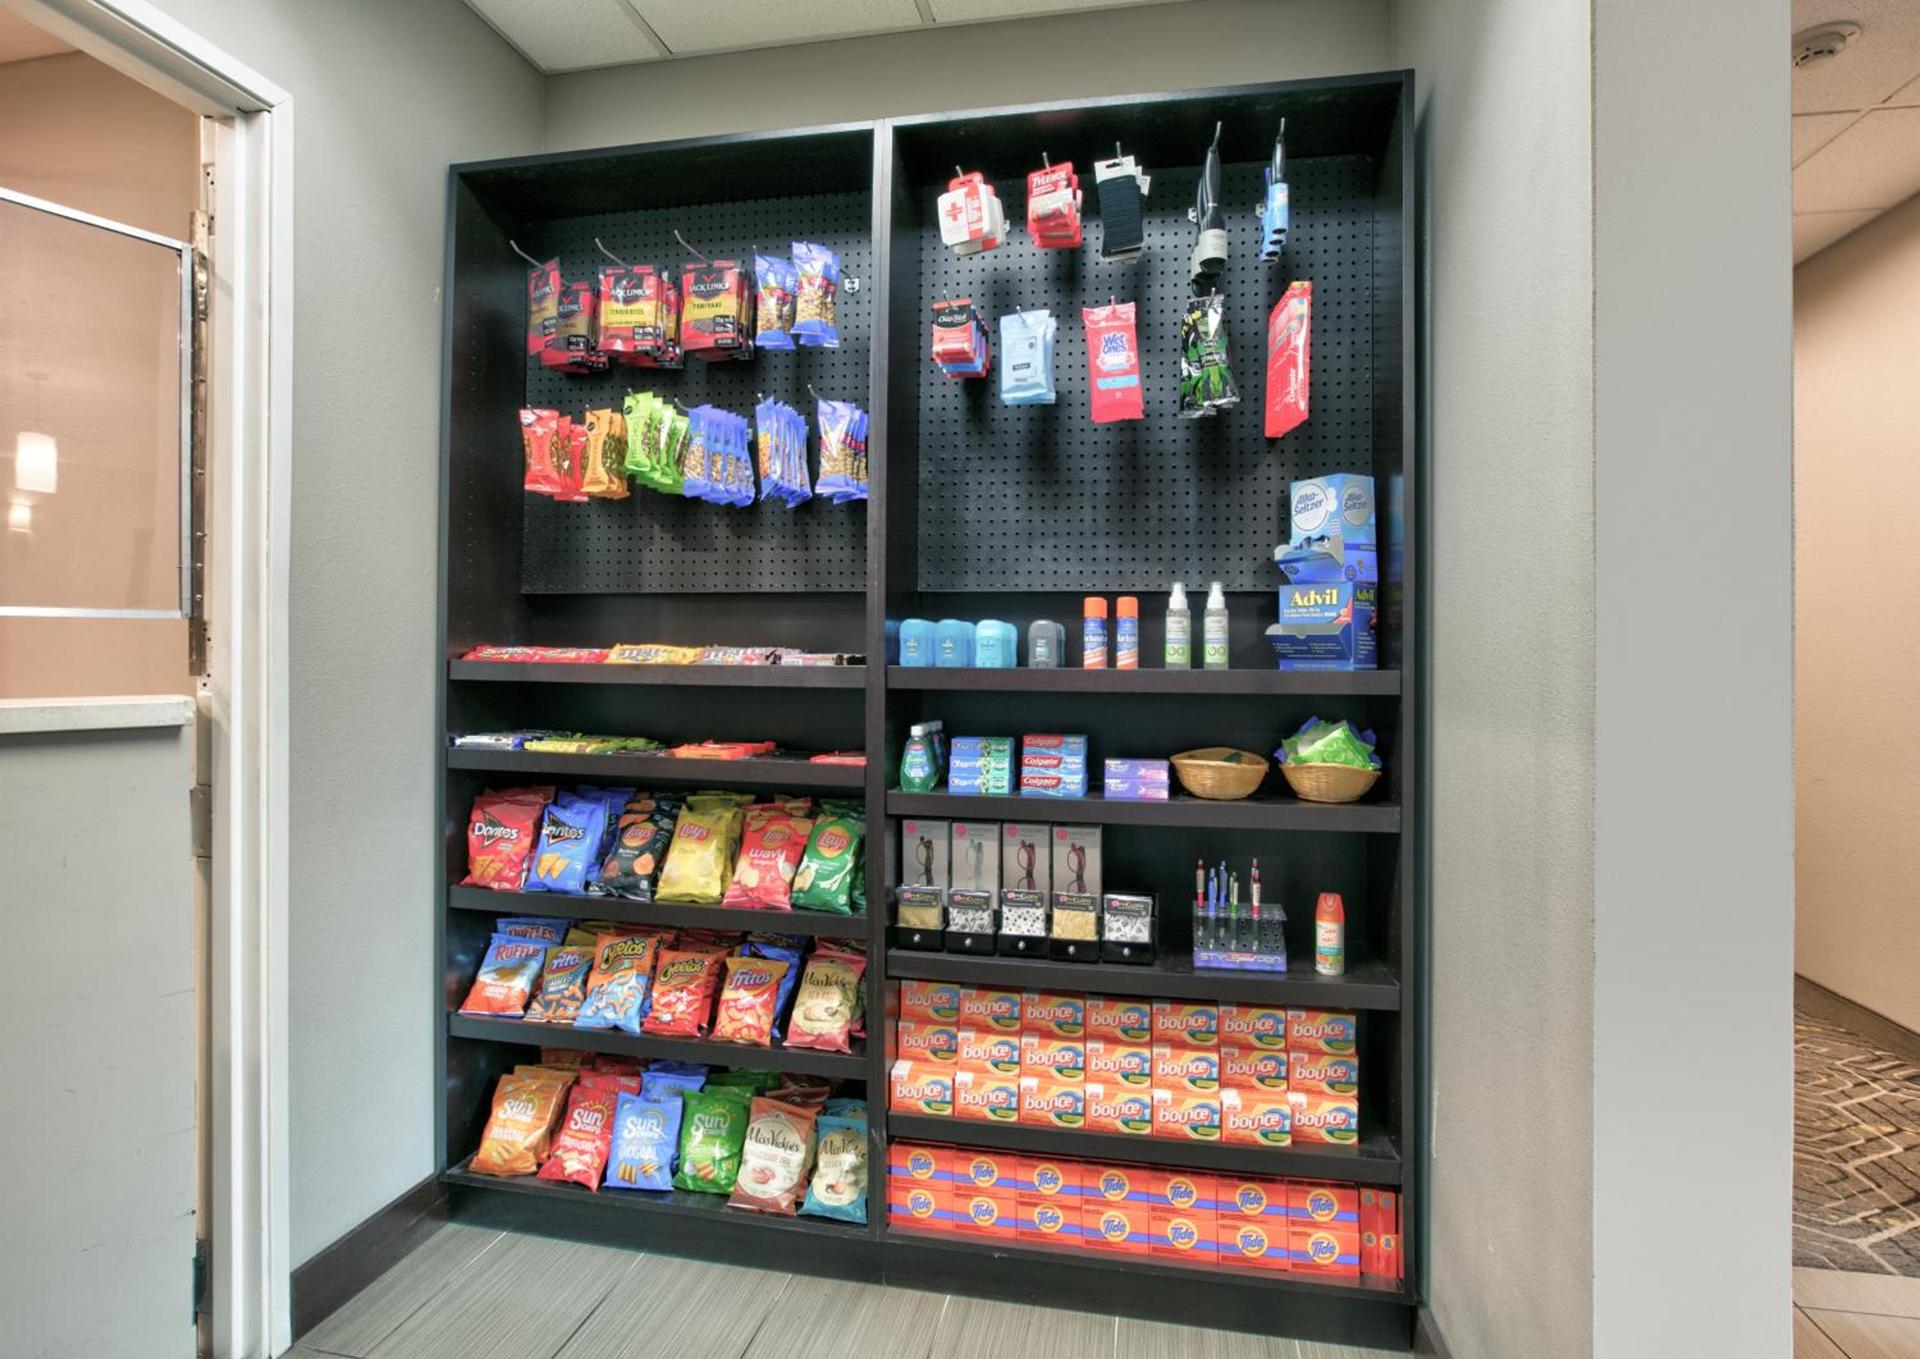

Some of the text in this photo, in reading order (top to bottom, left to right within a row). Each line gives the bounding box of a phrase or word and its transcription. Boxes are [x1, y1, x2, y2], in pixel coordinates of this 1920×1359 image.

[1032, 171, 1067, 187] TYLENOL
[1103, 334, 1125, 346] Wet
[1103, 344, 1127, 354] Ones
[1287, 367, 1296, 403] Colgate
[1294, 499, 1324, 516] Seltzer
[1289, 588, 1338, 606] Advil
[1356, 590, 1375, 601] Advil
[1025, 737, 1057, 746] Colgate
[1024, 757, 1058, 766] Colgate
[1023, 777, 1058, 786] Colgate
[474, 822, 519, 839] Doritos
[542, 823, 585, 839] Doritos
[680, 824, 711, 839] Lay's
[818, 832, 850, 849] Lay's
[599, 937, 648, 974] Cheetos
[659, 959, 705, 984] Cheetos
[728, 968, 771, 990] Fritos
[905, 991, 952, 1006] bounce
[964, 999, 1012, 1016] bounce
[1027, 1005, 1074, 1021] bounce
[1091, 1011, 1141, 1026] bounce
[1158, 1015, 1208, 1030] bounce
[1224, 1017, 1276, 1033] bounce
[1293, 1022, 1346, 1038] bounce
[903, 1033, 950, 1048] bounce
[963, 1044, 1011, 1061] bounce
[1026, 1049, 1074, 1066] bounce
[1091, 1056, 1142, 1072] bounce
[1158, 1060, 1209, 1076] bounce
[1226, 1060, 1278, 1075] bounce
[1295, 1064, 1347, 1080] bounce
[896, 1083, 943, 1099] bounce
[960, 1089, 1008, 1106] bounce
[498, 1099, 536, 1120] Sun
[1024, 1094, 1073, 1110] bounce
[1091, 1102, 1142, 1119] bounce
[1159, 1107, 1211, 1123] bounce
[570, 1108, 604, 1131] Sun
[623, 1115, 660, 1138] Sun
[692, 1114, 728, 1136] Sun
[1229, 1113, 1281, 1129] bounce
[1295, 1111, 1348, 1127] bounce
[749, 1126, 771, 1145] Miss
[910, 1158, 933, 1173] Tide
[972, 1164, 995, 1180] Tide
[1037, 1171, 1060, 1187] Tide
[1103, 1177, 1126, 1193] Tide
[1169, 1186, 1194, 1201] Tide
[1238, 1192, 1264, 1209] Tide
[910, 1196, 933, 1211] Tide
[972, 1204, 995, 1219] Tide
[1310, 1199, 1335, 1215] Tide
[1036, 1211, 1060, 1226] Tide
[1103, 1219, 1127, 1234] Tide
[1170, 1226, 1195, 1242] Tide
[1240, 1235, 1265, 1250] Tide
[1311, 1241, 1336, 1257] Tide
